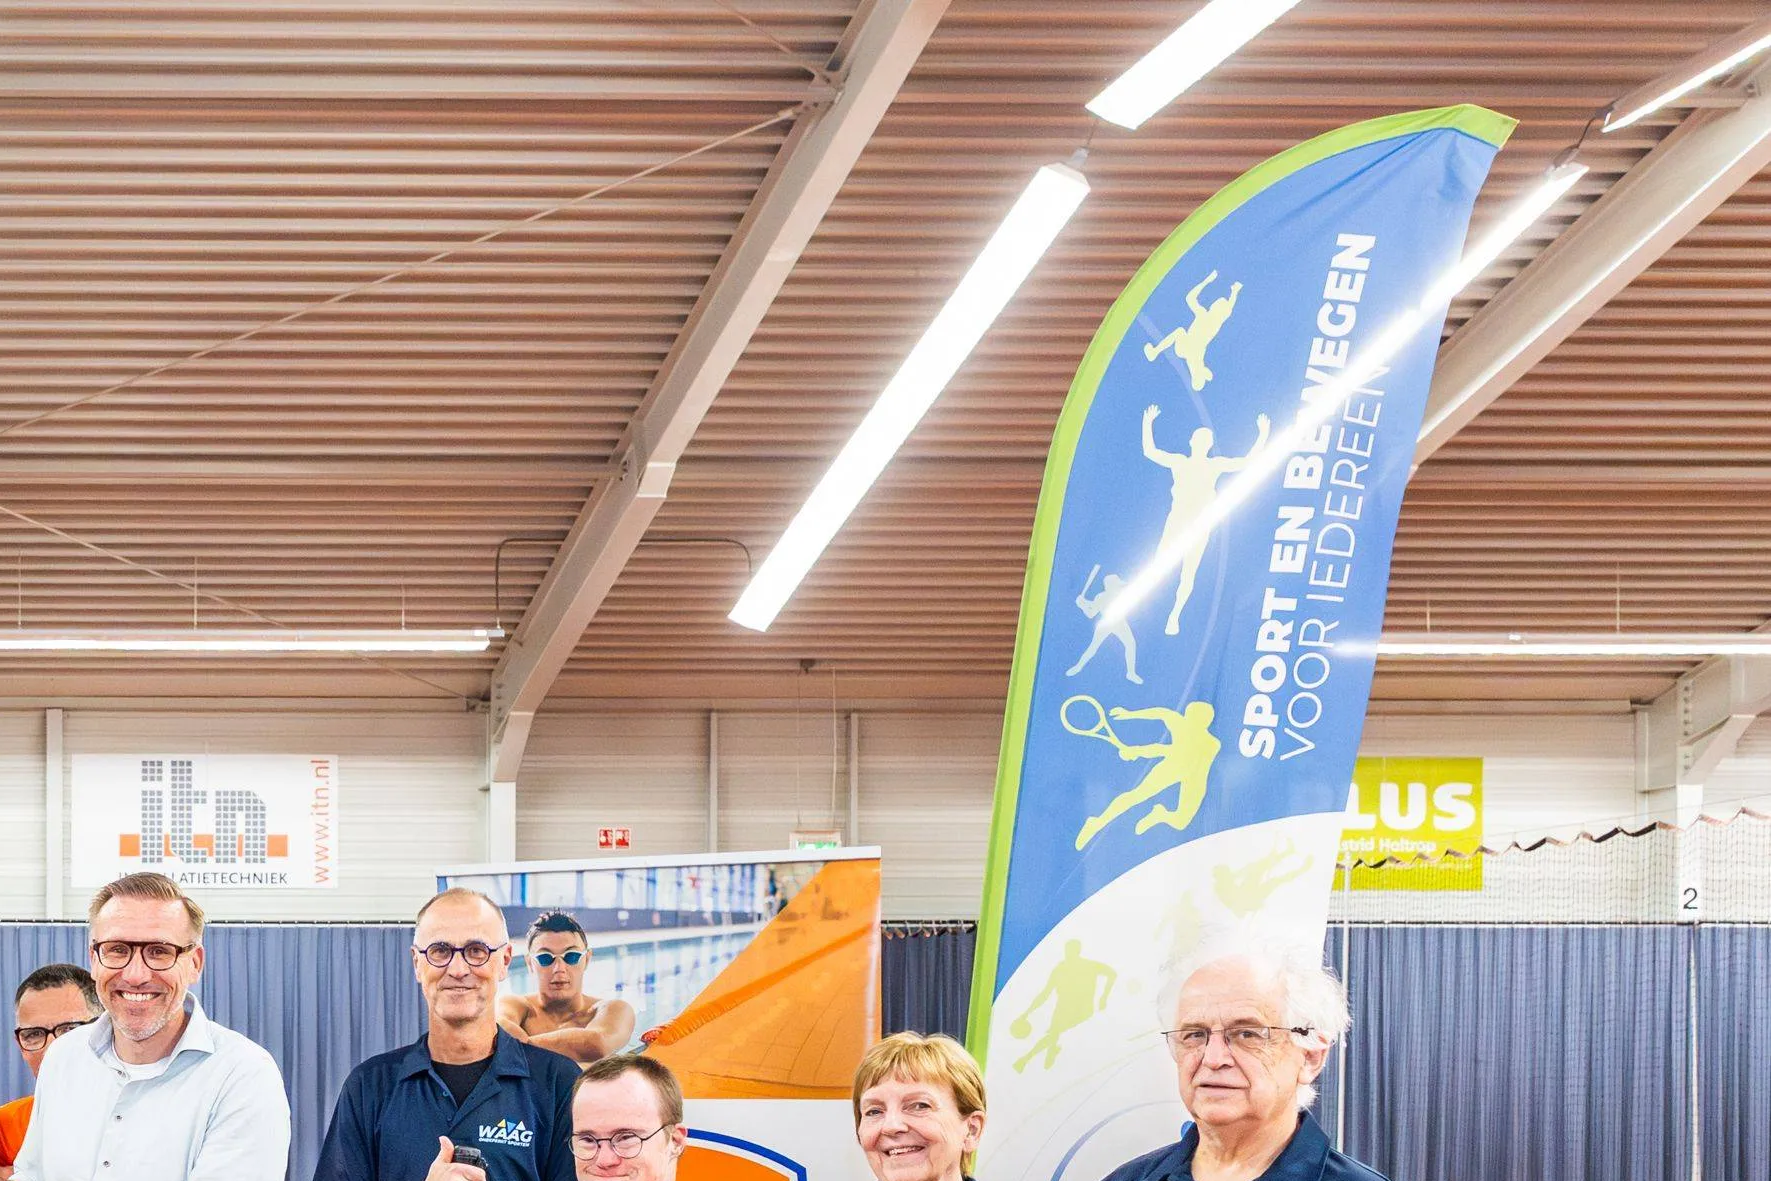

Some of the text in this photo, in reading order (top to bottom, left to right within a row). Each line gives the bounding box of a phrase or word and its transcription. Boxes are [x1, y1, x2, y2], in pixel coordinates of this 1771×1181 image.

[1238, 233, 1376, 760] SPORT EN BEWEGEN
[1279, 618, 1339, 761] VOOR
[310, 760, 330, 883] www.itn.nl
[1683, 887, 1698, 909] 2
[479, 1125, 533, 1142] WAAG
